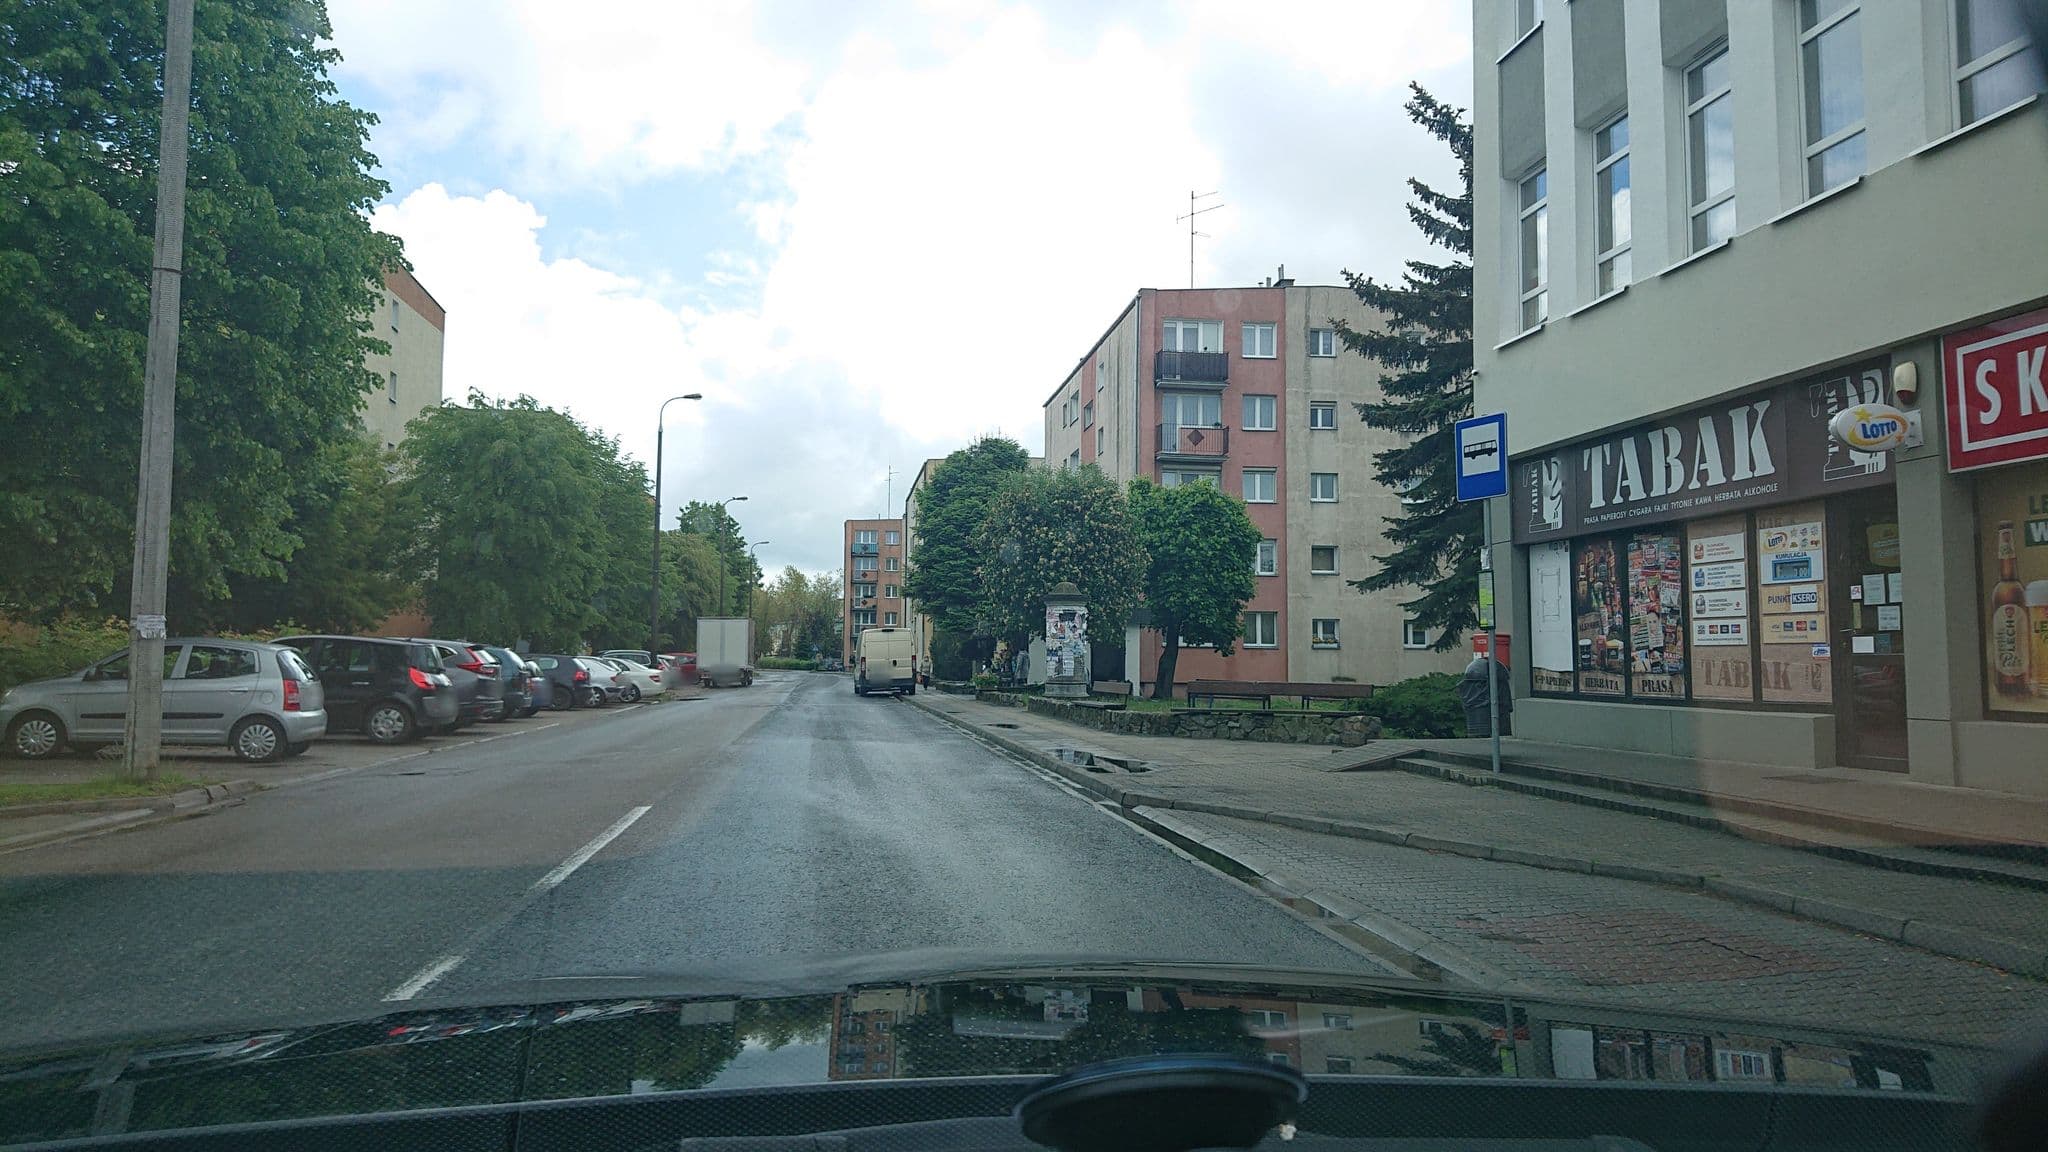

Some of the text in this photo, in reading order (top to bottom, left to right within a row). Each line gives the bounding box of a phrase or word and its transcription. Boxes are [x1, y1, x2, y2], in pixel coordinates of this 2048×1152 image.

[1861, 420, 1898, 440] LOTTO
[1583, 400, 1776, 509] TABAK
[1583, 483, 1779, 525] PRASA PAPIEROSY CYGARA FAJKI TYTONIE KAWA HERBATA ALKOHOLE
[1768, 592, 1816, 605] PUNKT KSERO
[2006, 618, 2016, 652] LECH
[1585, 677, 1619, 691] HERBATA
[1641, 679, 1675, 693] PRASA
